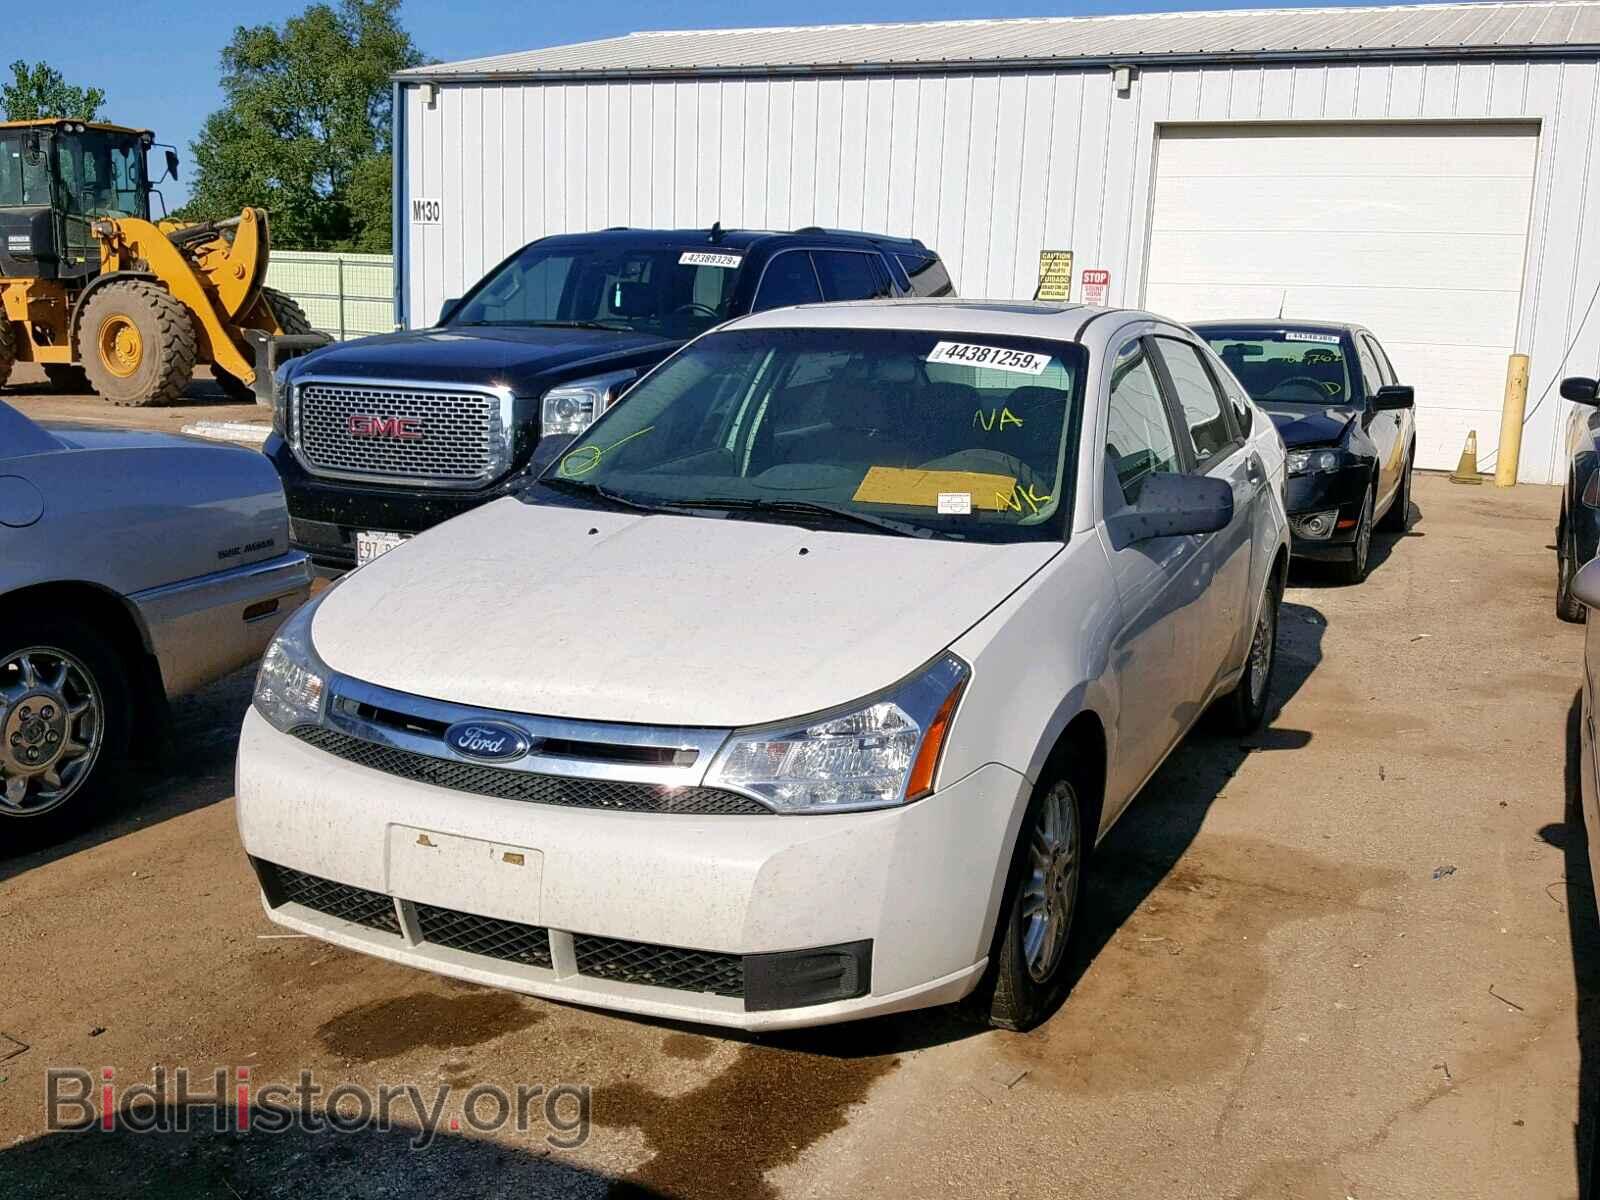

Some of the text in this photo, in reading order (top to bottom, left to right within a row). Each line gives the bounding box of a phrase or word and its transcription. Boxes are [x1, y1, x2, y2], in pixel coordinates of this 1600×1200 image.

[413, 200, 440, 222] M130
[1042, 252, 1070, 260] CAUTION
[1084, 271, 1107, 283] STOP
[348, 415, 424, 439] GMC
[972, 407, 1023, 432] NA
[458, 726, 507, 753] Ford
